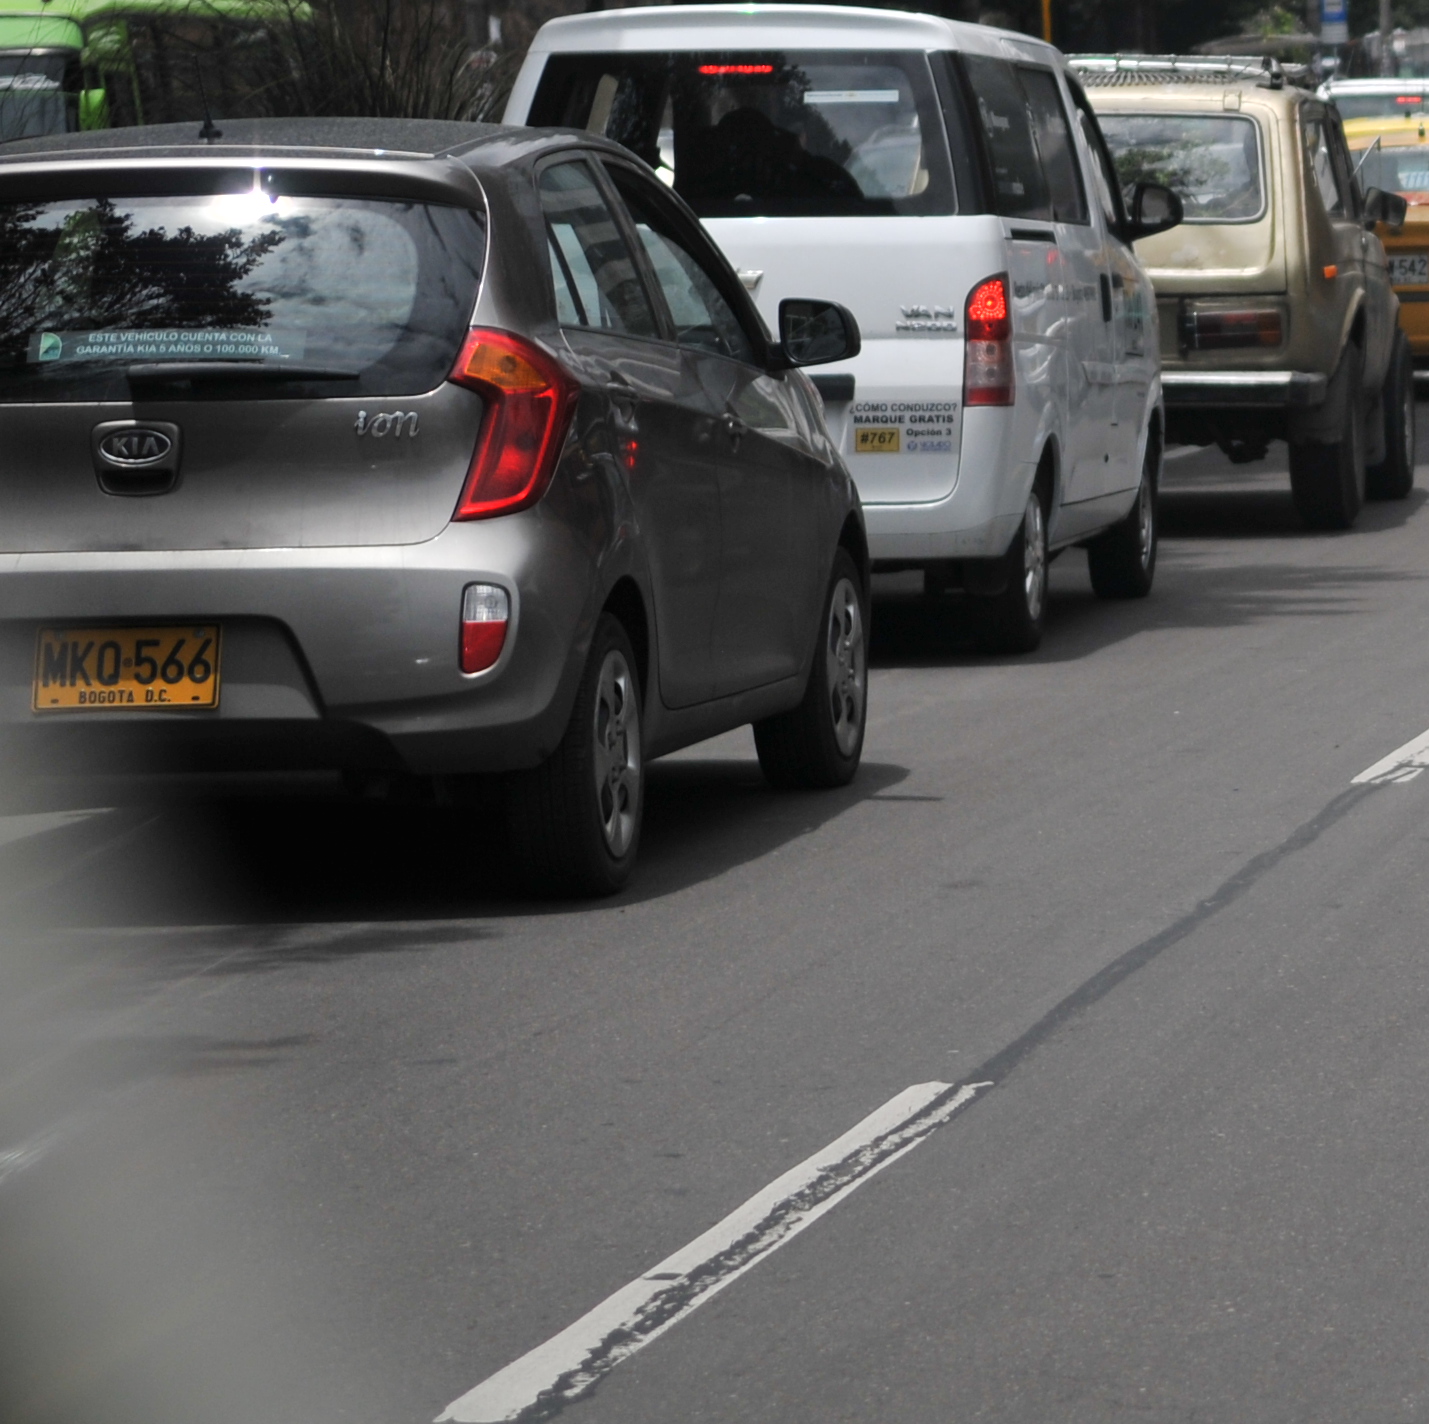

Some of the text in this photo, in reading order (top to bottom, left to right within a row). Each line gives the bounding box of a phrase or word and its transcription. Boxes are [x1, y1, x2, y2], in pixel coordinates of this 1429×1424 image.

[900, 304, 955, 320] VAN
[88, 333, 117, 342] ESTE
[180, 332, 227, 342] CUENTA
[229, 333, 256, 342] CON
[257, 333, 273, 342] LA
[136, 344, 157, 354] KIA
[159, 344, 167, 353] 5
[168, 342, 201, 353] AÑOS
[203, 344, 214, 354] O
[216, 344, 259, 355] 100.000
[849, 402, 958, 414] ¿CÓMO CONDUZCO?
[353, 409, 420, 438] ion
[853, 414, 954, 424] MARQUE GRATIS
[860, 432, 896, 445] #767
[905, 428, 952, 438] Opción 3
[112, 436, 160, 456] KIA
[79, 690, 134, 704] BOGOTA
